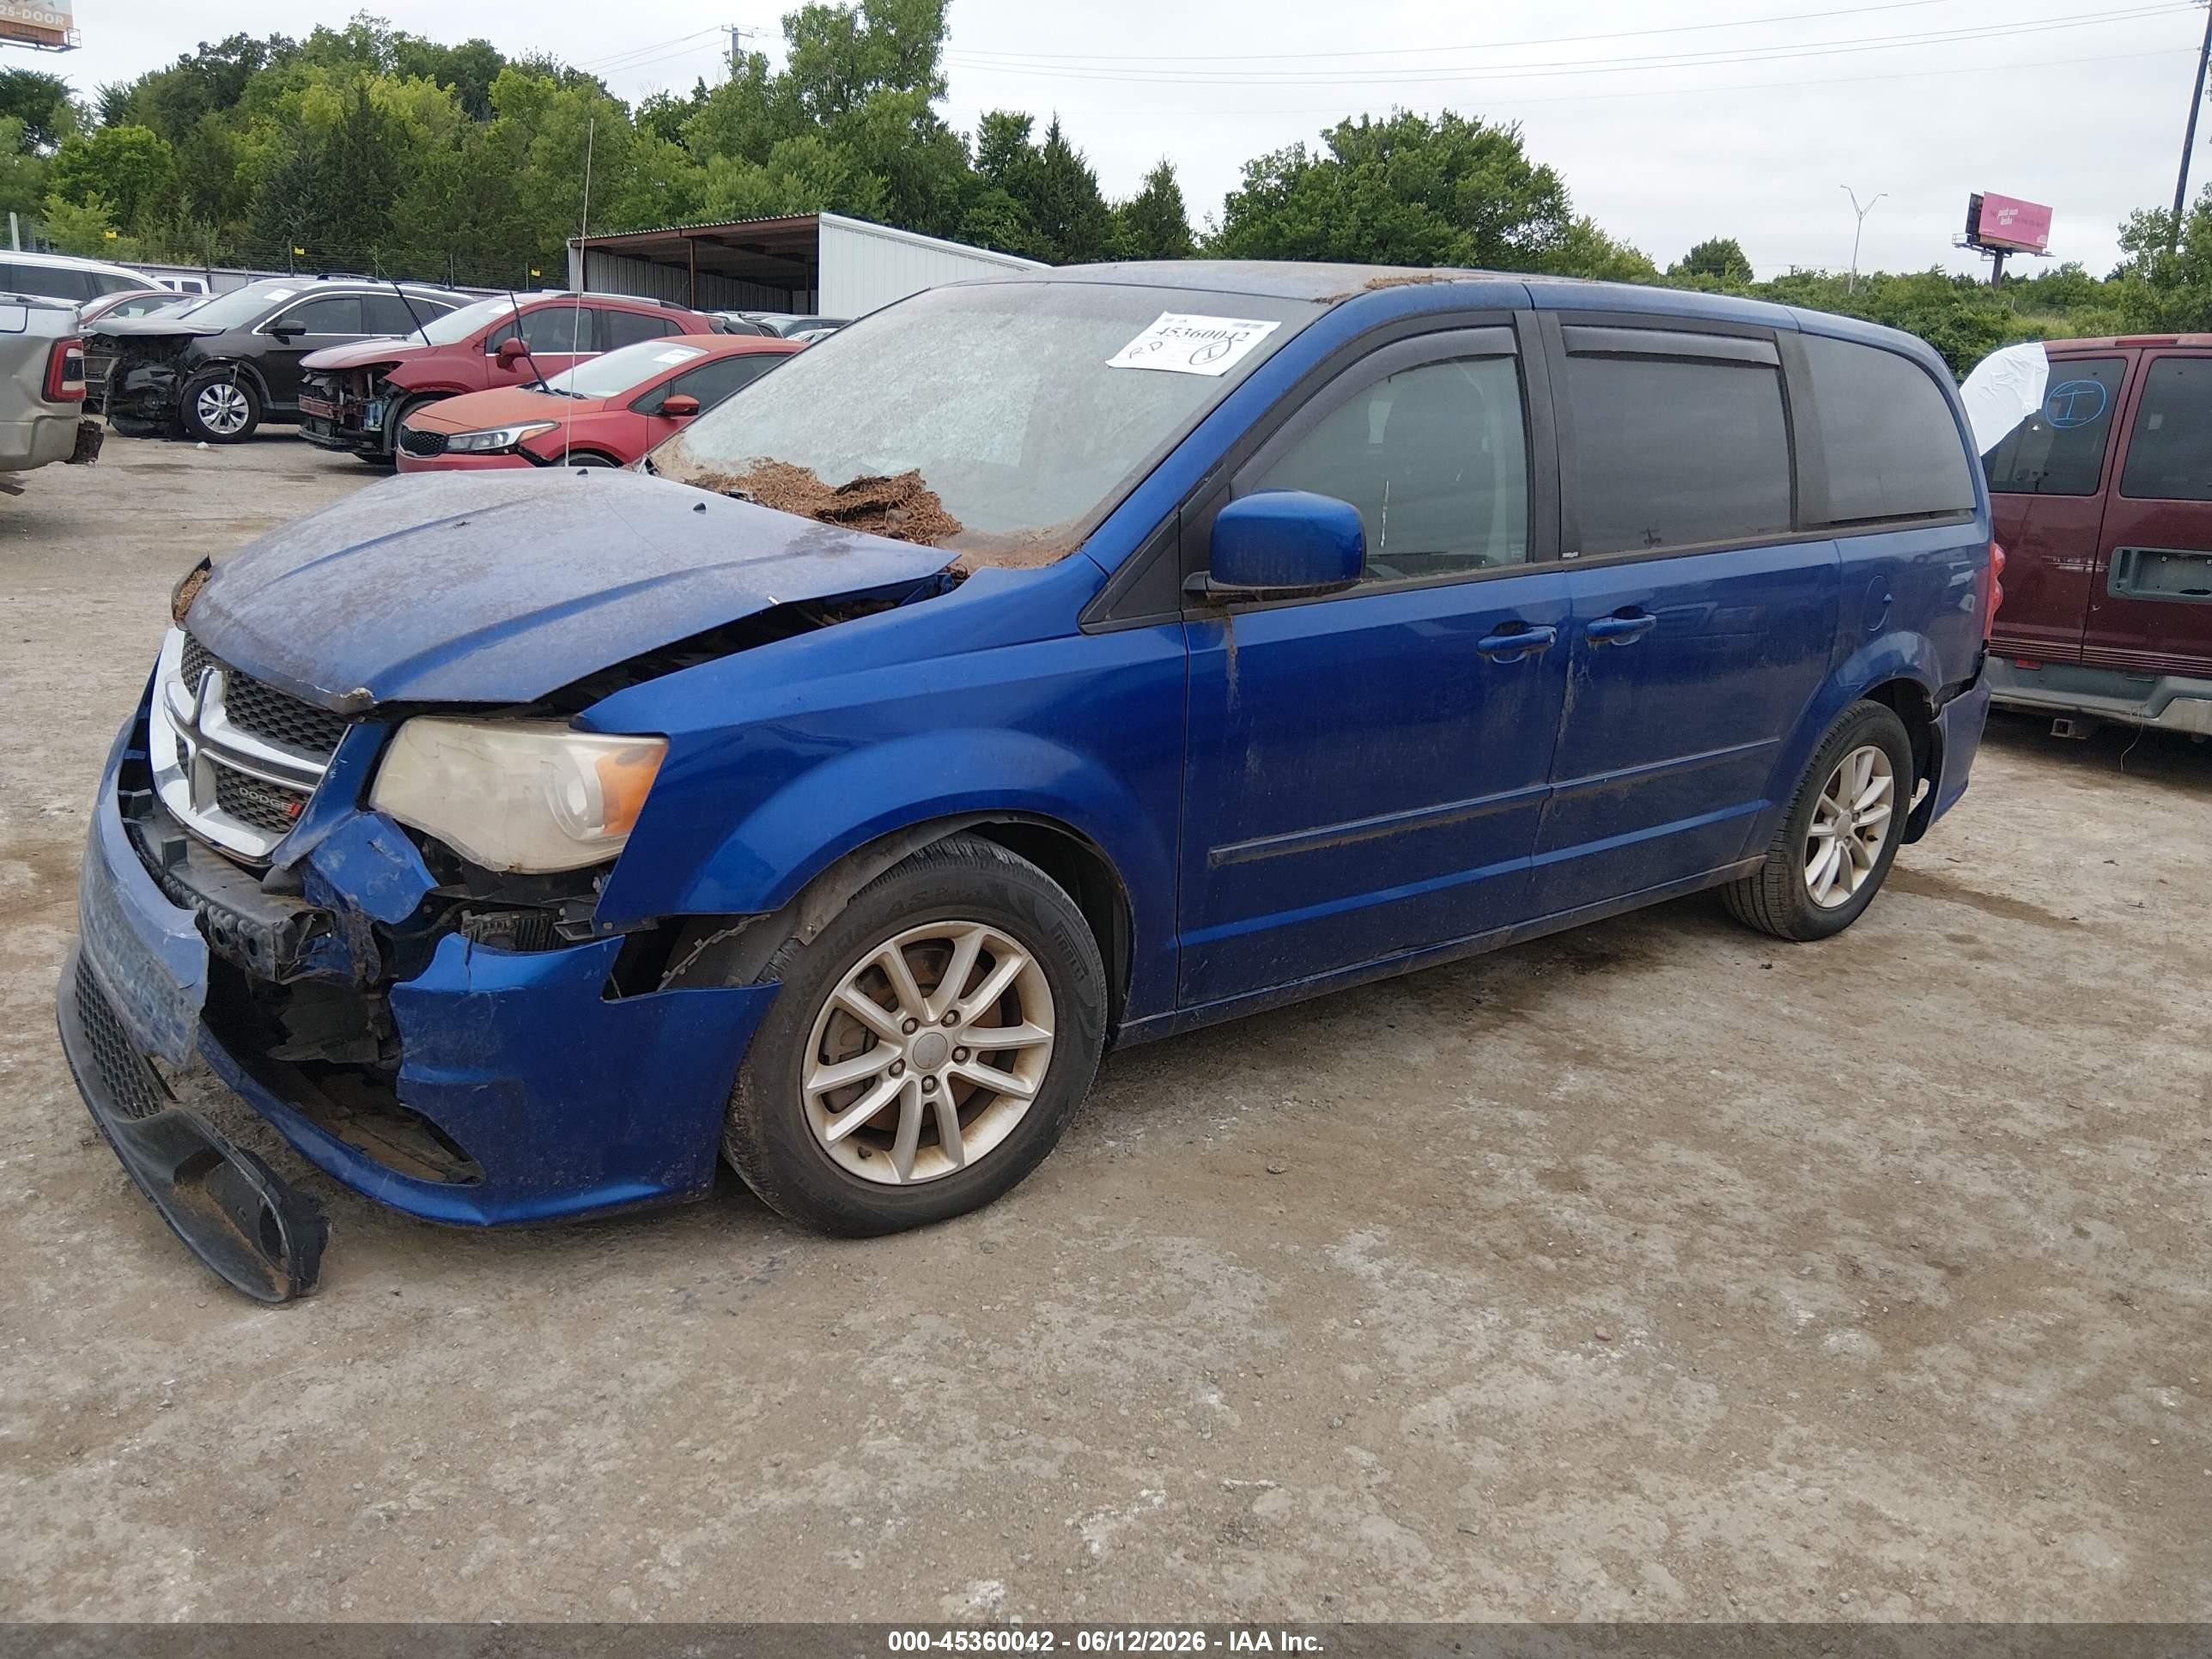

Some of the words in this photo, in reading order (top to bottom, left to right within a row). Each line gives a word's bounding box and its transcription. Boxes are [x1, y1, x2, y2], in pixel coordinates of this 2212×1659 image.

[1155, 325, 1251, 342] 45360042
[239, 787, 293, 814] DODGE
[1050, 920, 1090, 982] PIRELLI
